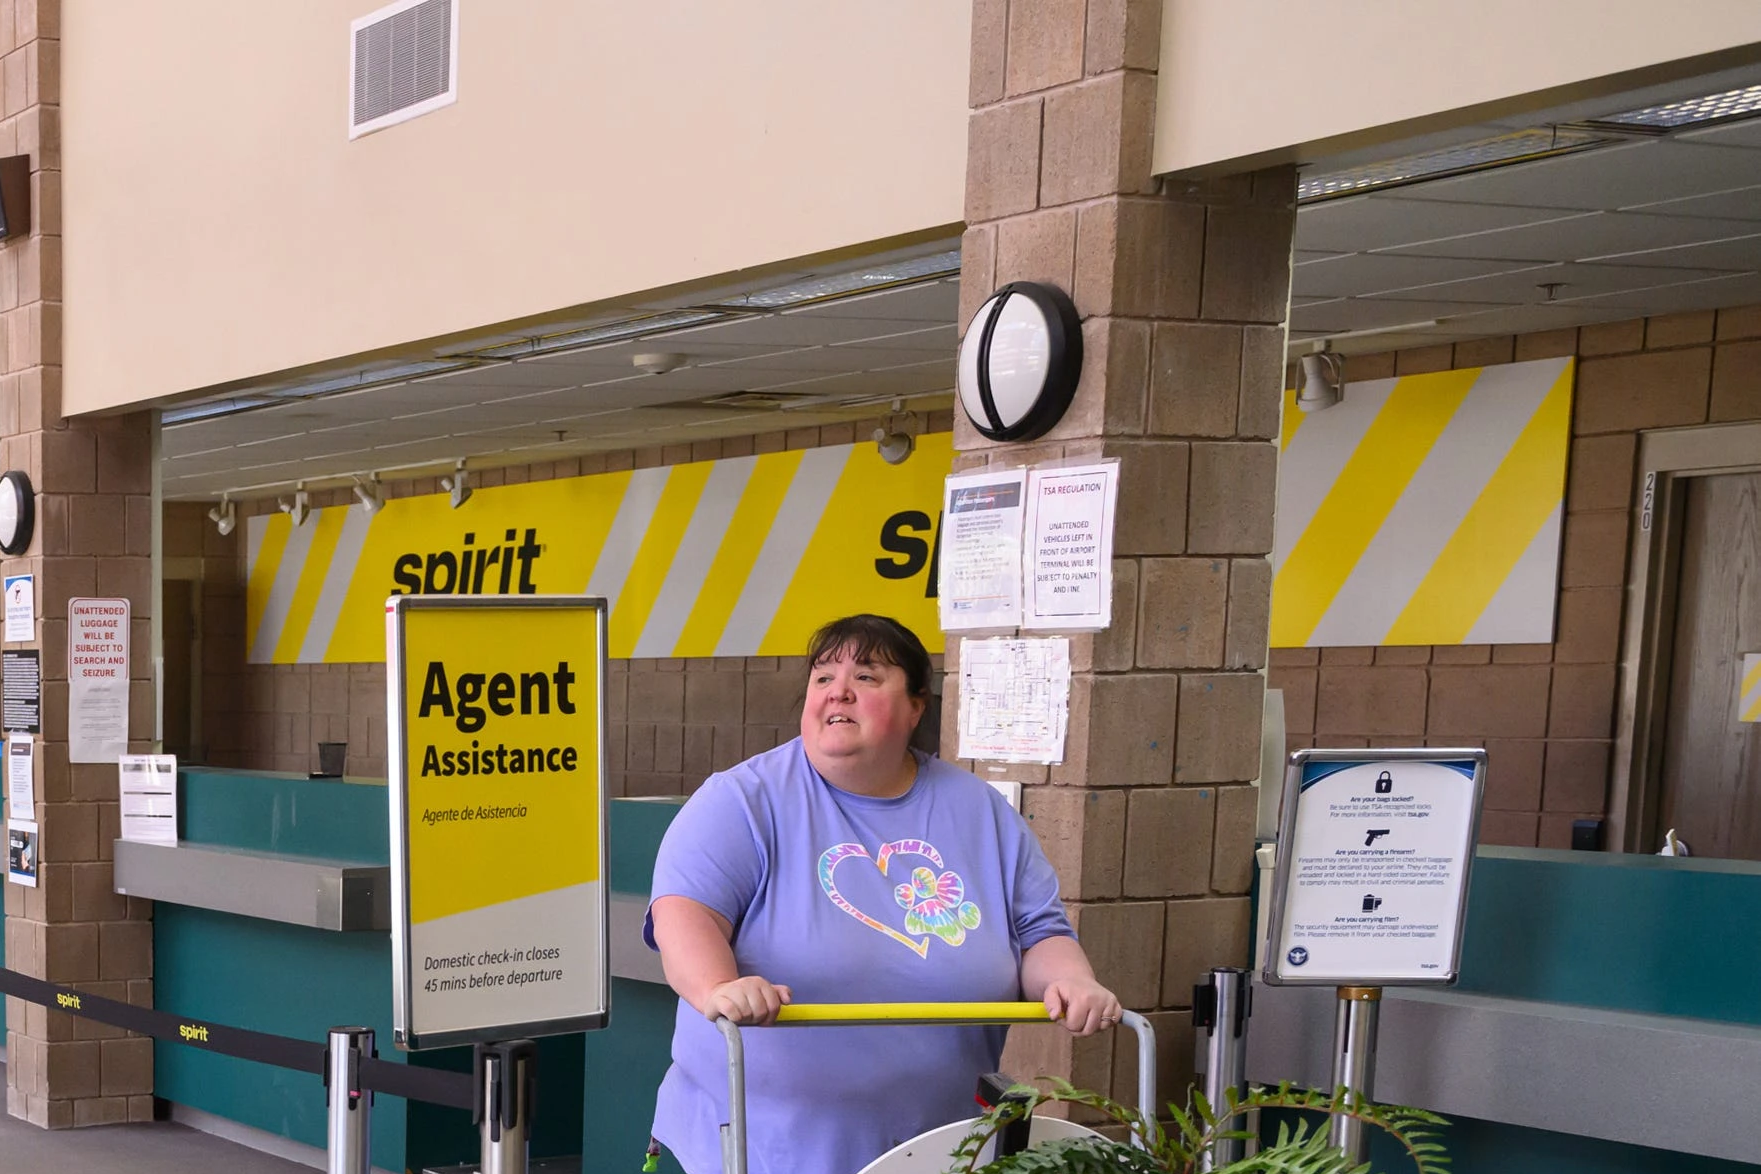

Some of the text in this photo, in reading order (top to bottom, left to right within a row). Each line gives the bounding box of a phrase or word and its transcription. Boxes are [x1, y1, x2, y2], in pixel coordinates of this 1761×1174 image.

[1043, 483, 1101, 495] TSA REGULATION
[1049, 521, 1089, 530] UNATTENDED
[1043, 535, 1071, 543] VEHICLES
[1071, 534, 1085, 542] LEFT
[1039, 548, 1059, 556] FRONT
[1070, 546, 1096, 555] AIRPORT
[390, 528, 542, 594] spirit
[1062, 573, 1070, 581] TO
[1053, 586, 1067, 594] AND
[74, 606, 125, 616] UNATTENDED
[80, 619, 118, 628] LUGGAGE
[83, 632, 115, 640] WILL BE
[75, 644, 123, 652] SUBJECT TO
[73, 656, 125, 665] SEARCH AND
[82, 669, 116, 677] SEIZURE
[418, 661, 576, 733] Agent
[421, 740, 578, 777] Assistance
[422, 803, 527, 826] Agente de Asistencia
[424, 946, 560, 971] Domestic check-in closes
[424, 968, 563, 993] 45 mins before departure
[56, 992, 81, 1010] spirit
[179, 1023, 209, 1042] spirit
